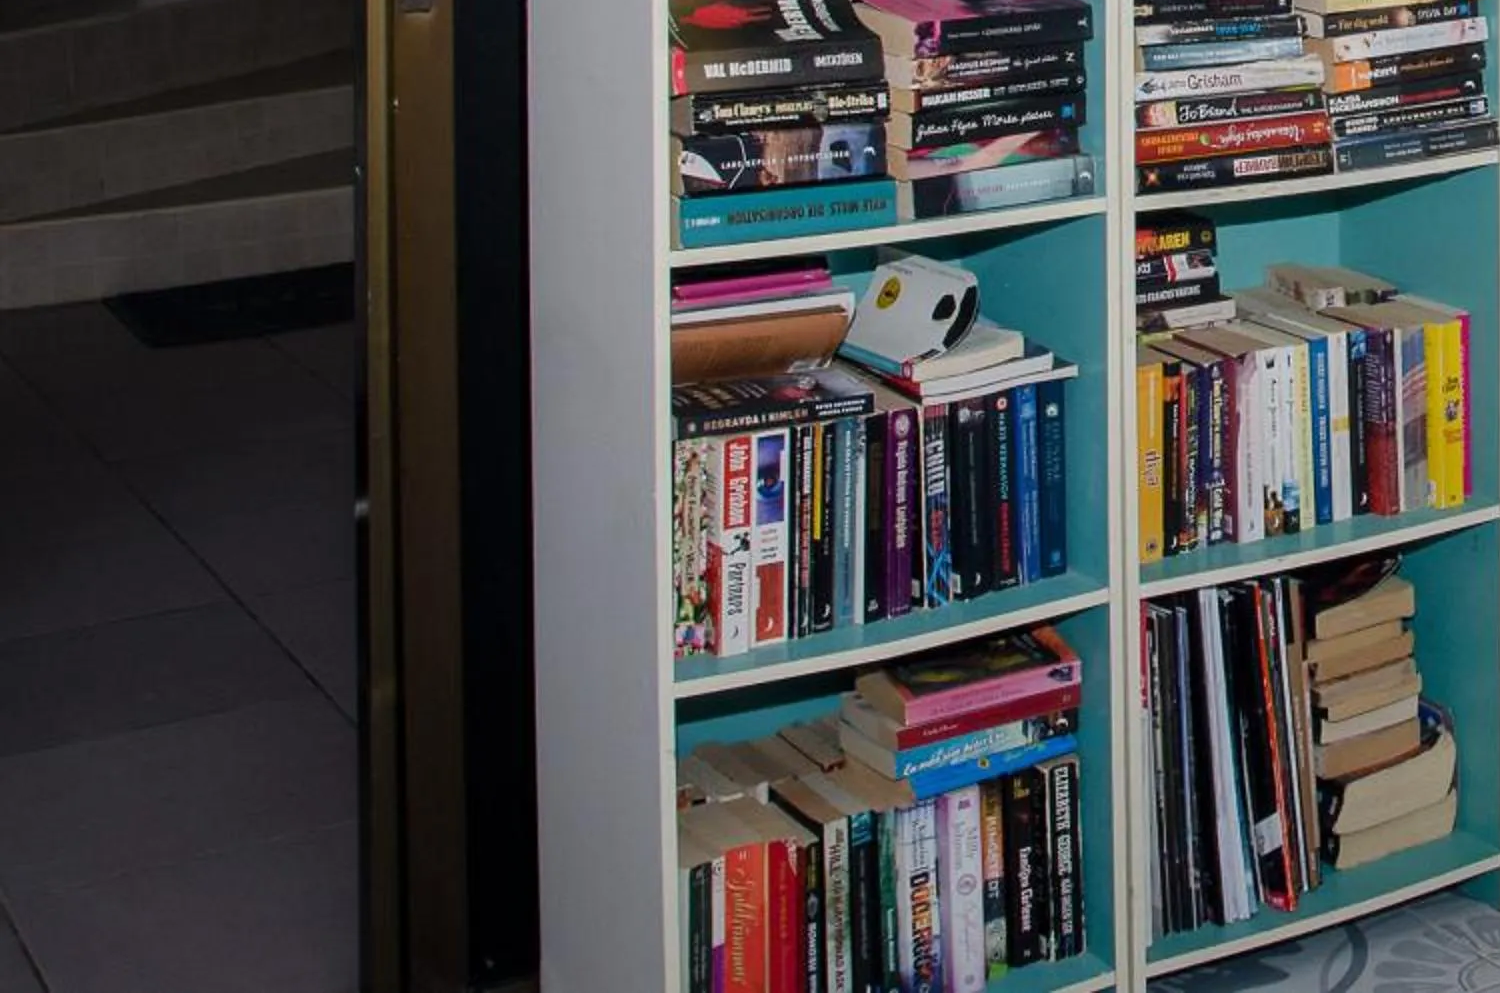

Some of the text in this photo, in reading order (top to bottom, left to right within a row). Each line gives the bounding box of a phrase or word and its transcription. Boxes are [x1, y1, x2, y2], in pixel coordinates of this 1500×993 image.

[703, 57, 793, 79] VAL McDERMID
[1187, 73, 1243, 90] Grisham
[1199, 97, 1239, 119] Brand
[728, 442, 749, 527] John Grisham
[926, 439, 946, 496] CHILD
[726, 562, 747, 617] Partners
[1054, 766, 1071, 832] ELIZABETH
[1057, 834, 1072, 876] GEORGE
